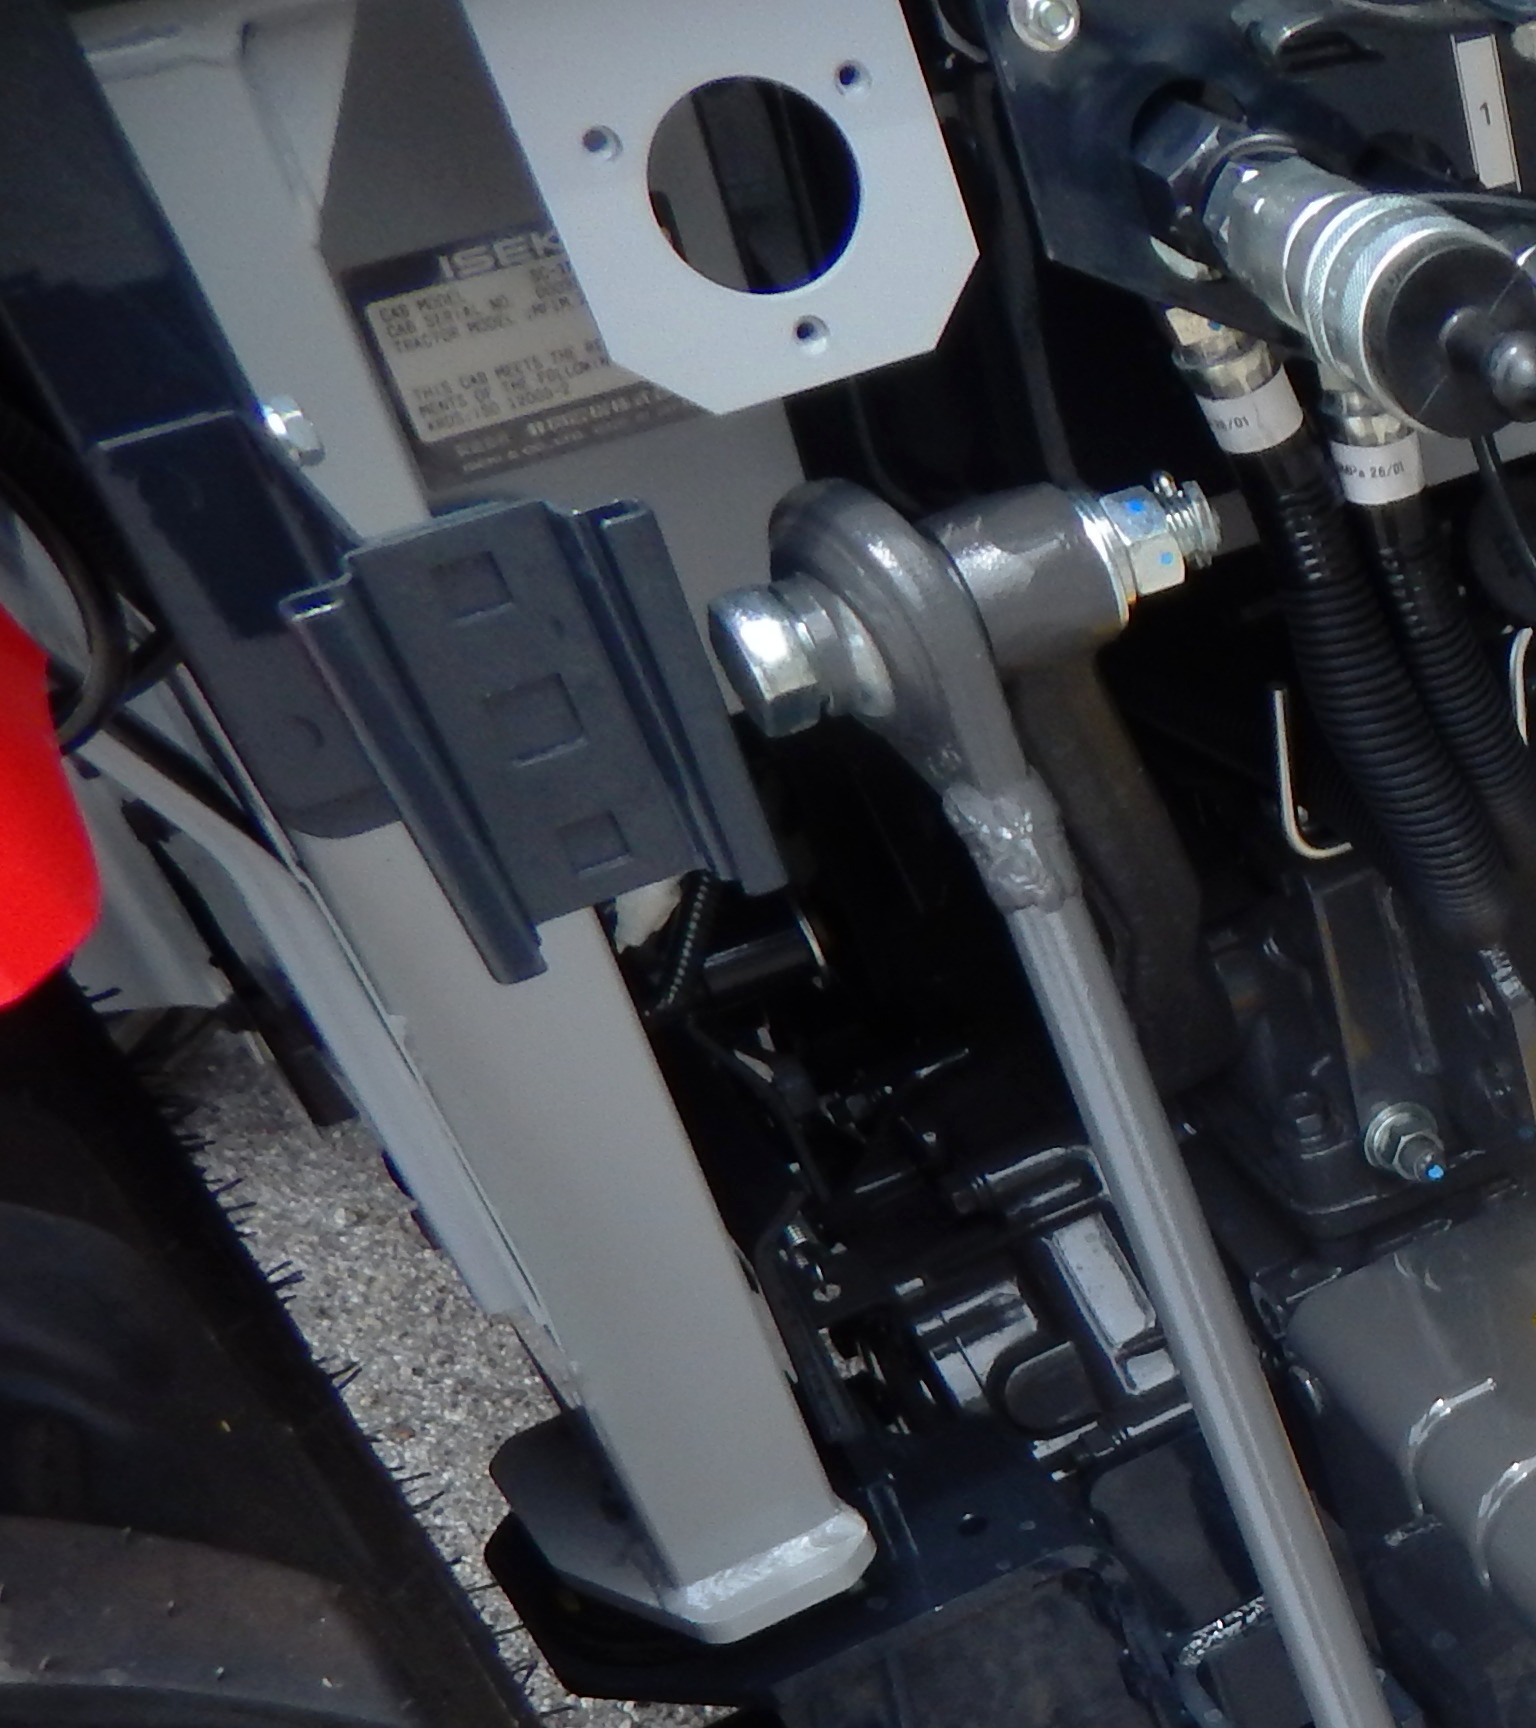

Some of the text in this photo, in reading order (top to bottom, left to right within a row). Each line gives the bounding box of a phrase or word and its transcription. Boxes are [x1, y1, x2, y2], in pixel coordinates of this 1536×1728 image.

[1480, 102, 1490, 125] 1
[438, 231, 563, 281] ISEK
[1371, 462, 1405, 479] 26/01
